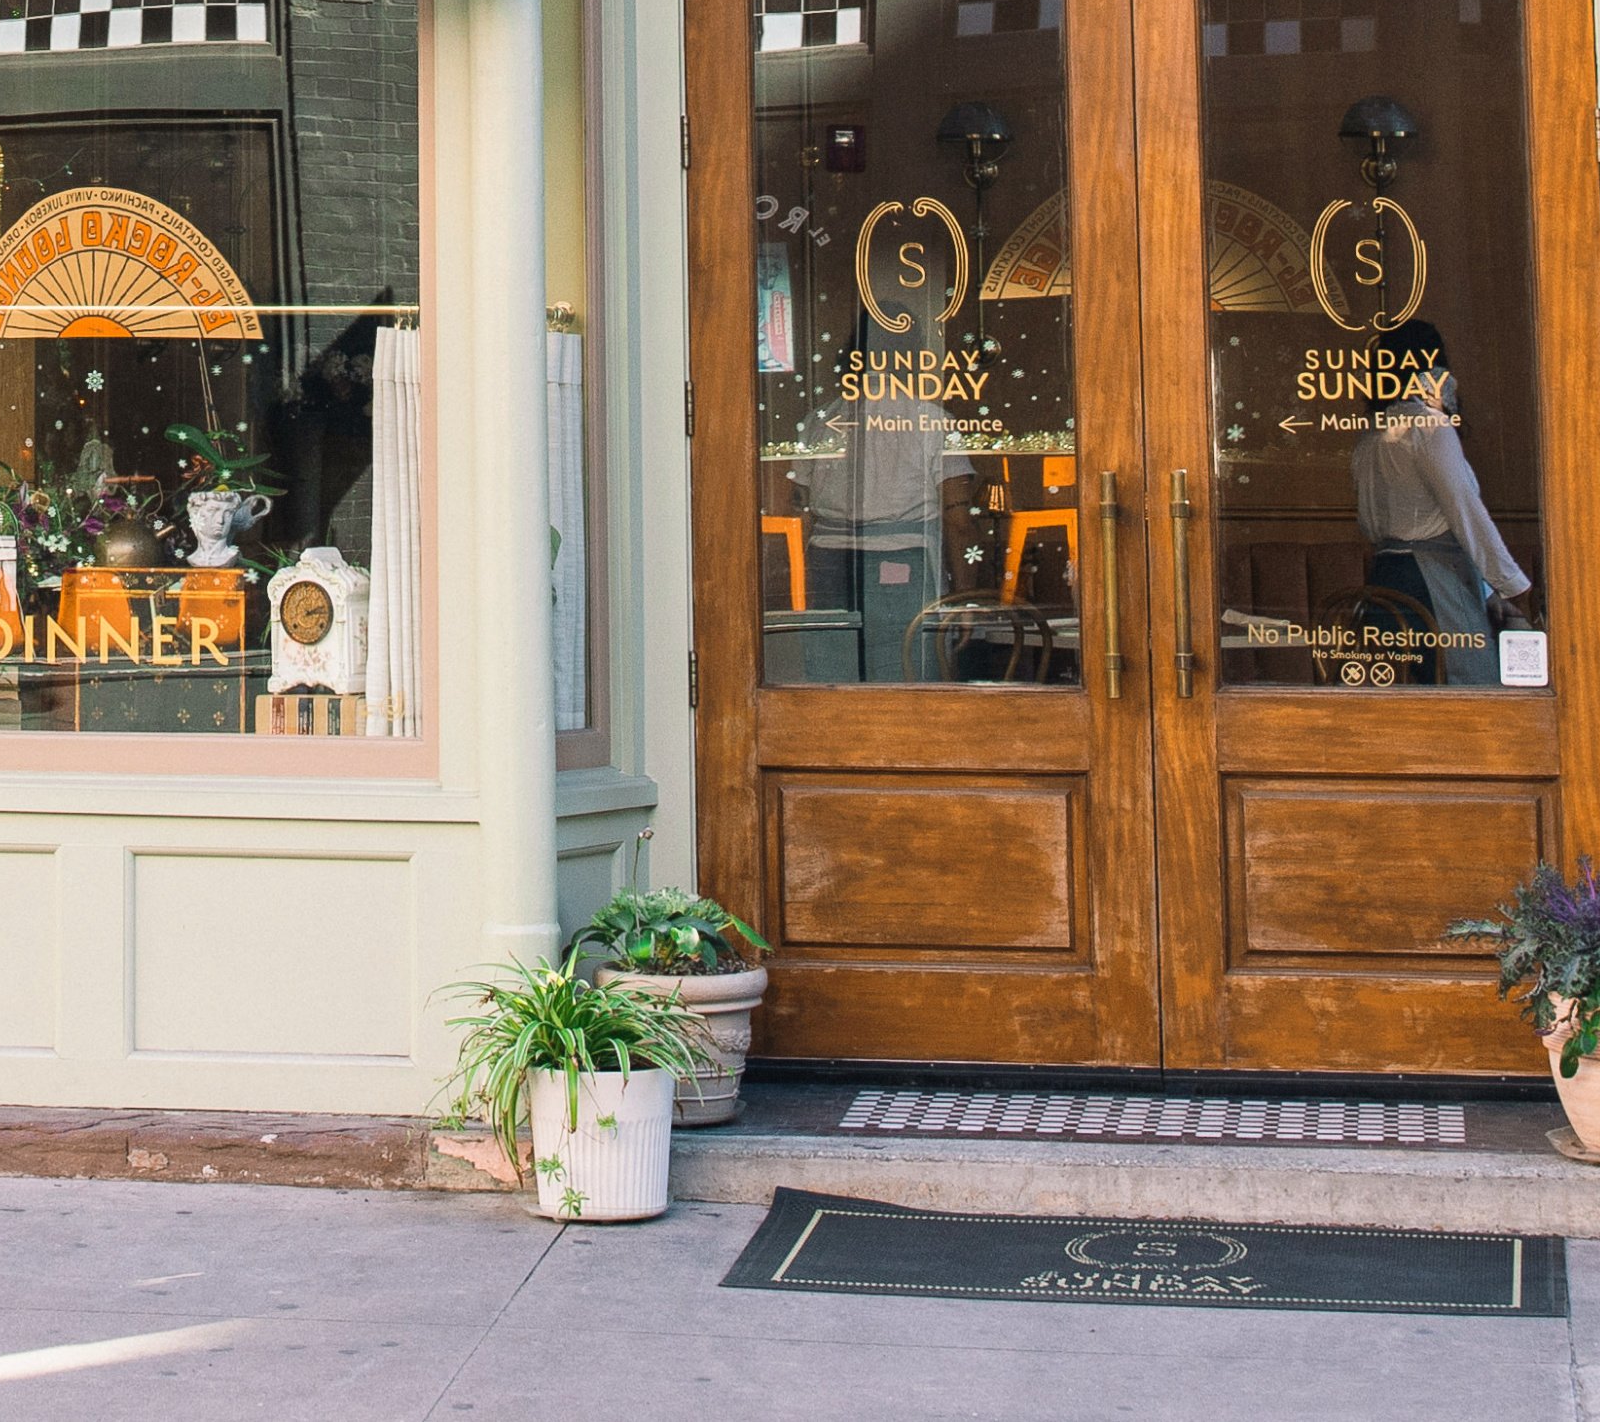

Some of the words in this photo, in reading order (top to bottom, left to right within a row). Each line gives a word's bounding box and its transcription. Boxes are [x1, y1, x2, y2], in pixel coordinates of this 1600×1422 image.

[898, 242, 926, 288] S
[1354, 239, 1384, 286] S
[849, 350, 980, 372] SUNDAY
[1305, 349, 1440, 370] SUNDAY
[841, 372, 989, 401] SUNDAY
[1296, 371, 1450, 401] SUNDAY
[866, 415, 913, 432] Main
[919, 415, 1004, 433] Entrance
[1320, 413, 1370, 431] Main
[1375, 412, 1462, 430] Entrance
[1247, 624, 1279, 645] No
[1287, 625, 1356, 646] Public
[1363, 626, 1486, 648] Restrooms
[1312, 649, 1327, 659] No
[1330, 649, 1372, 662] Smoking
[1374, 651, 1385, 660] or
[1387, 651, 1423, 663] Vaping
